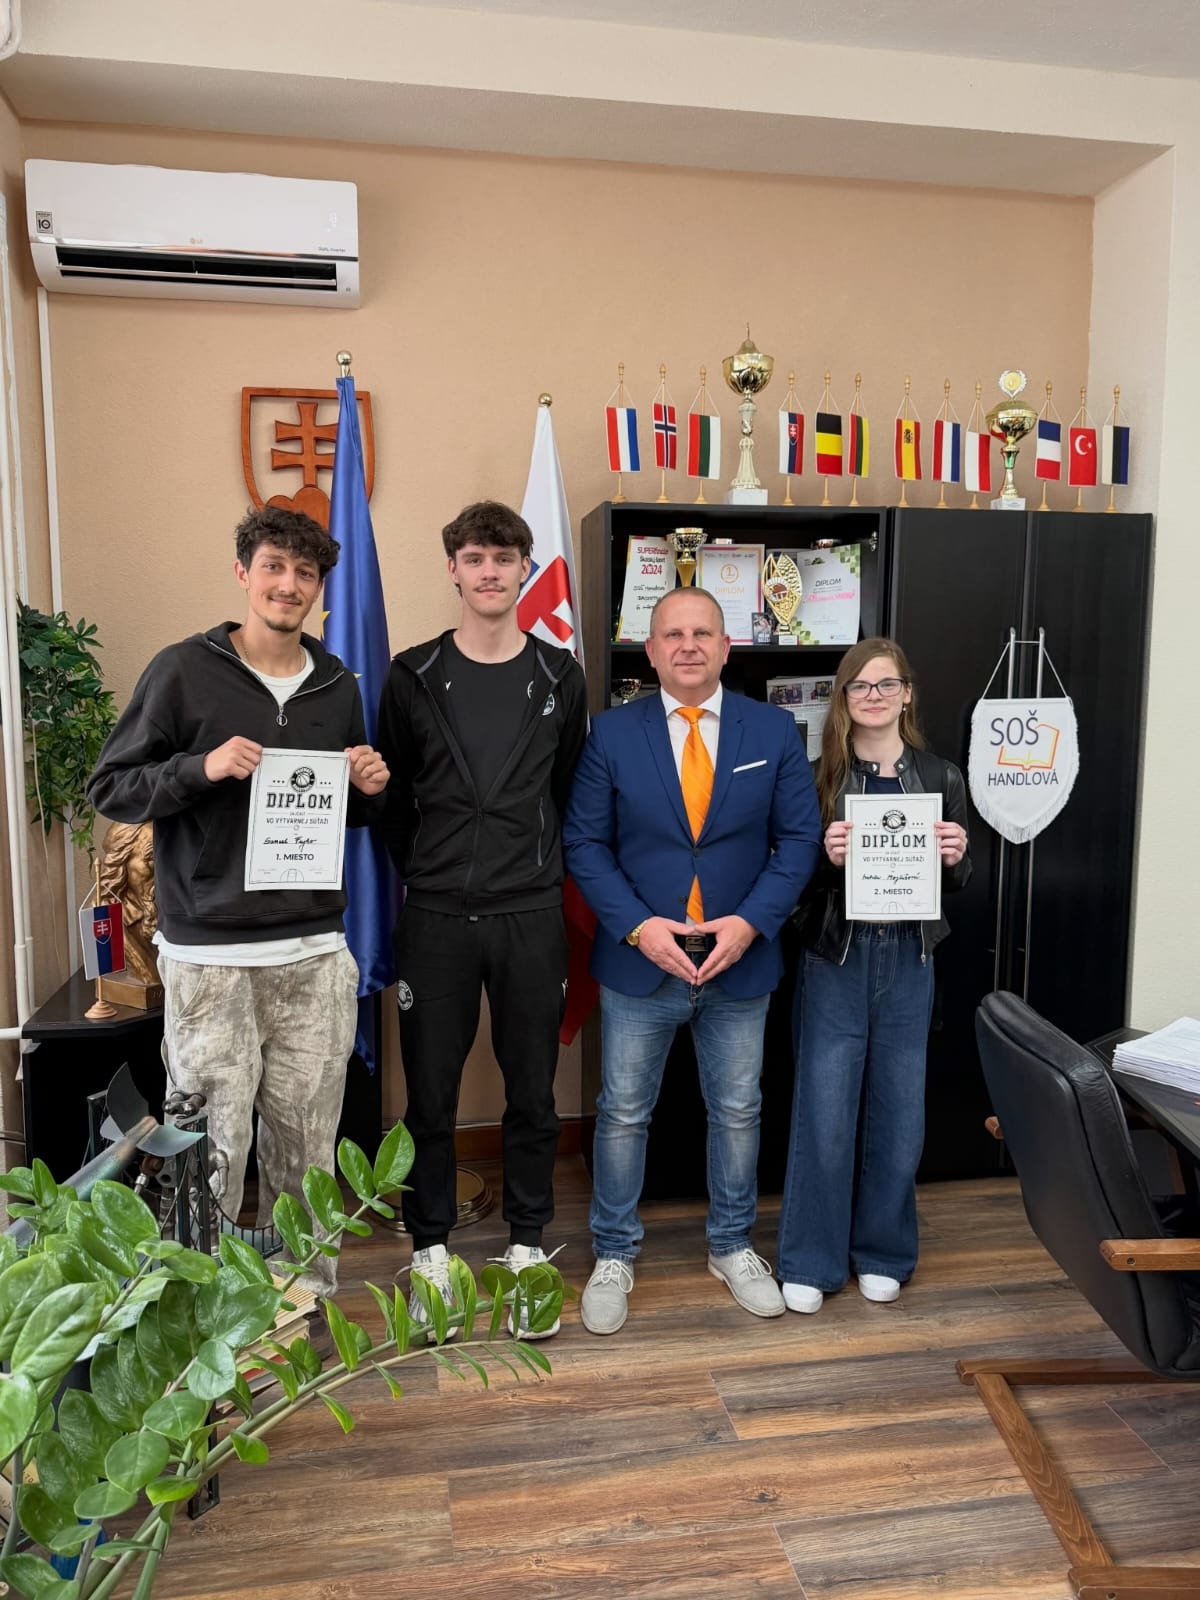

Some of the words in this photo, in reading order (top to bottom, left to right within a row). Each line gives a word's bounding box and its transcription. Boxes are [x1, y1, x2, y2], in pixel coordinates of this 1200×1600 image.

[641, 563, 663, 575] 2024
[815, 577, 842, 587] DIPLOM
[990, 709, 1039, 746] SOŠ
[988, 768, 1059, 786] HANDLOVÁ
[266, 793, 332, 809] DIPLOM
[862, 835, 926, 848] DIPLOM
[283, 853, 315, 861] MIESTO
[883, 888, 913, 896] MIESTO
